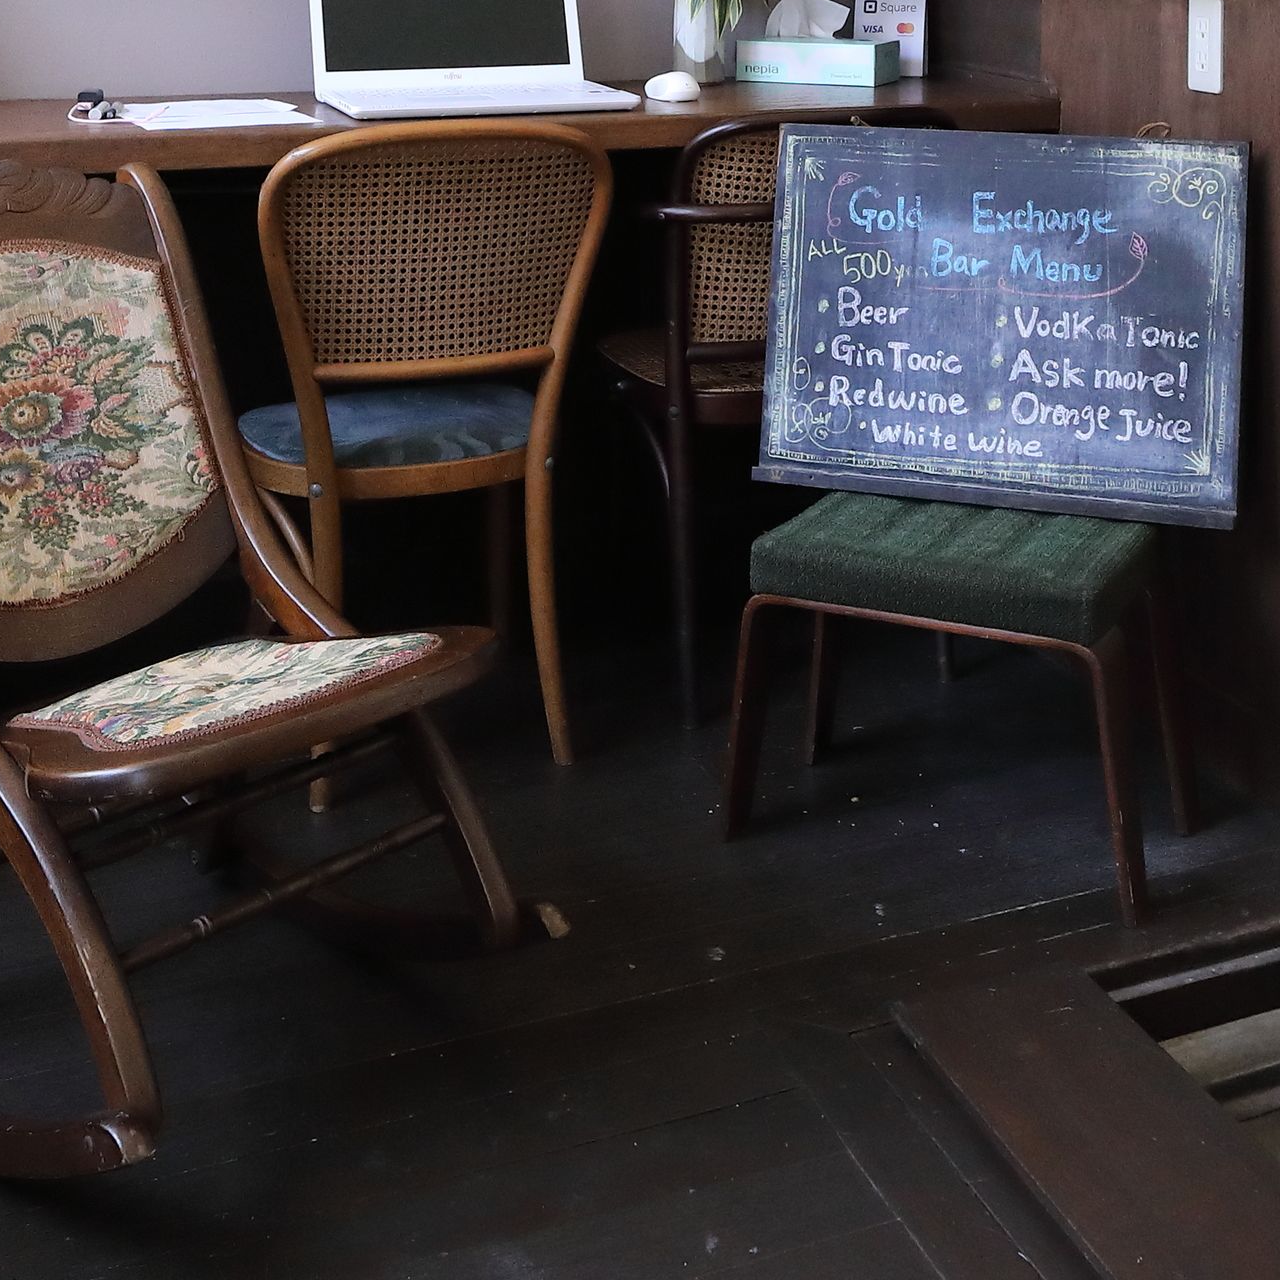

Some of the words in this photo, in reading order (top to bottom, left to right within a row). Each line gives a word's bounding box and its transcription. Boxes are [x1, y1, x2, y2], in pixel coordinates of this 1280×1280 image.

[880, 2, 917, 14] Square
[862, 25, 884, 33] VISA
[744, 64, 779, 75] nepia
[848, 185, 921, 233] Gold
[972, 191, 1118, 244] Exchange
[808, 238, 847, 261] ALL
[843, 249, 891, 283] 500
[931, 237, 991, 278] Bar
[1010, 244, 1104, 283] Menu
[837, 285, 909, 327] Beer
[831, 333, 885, 366] Gin
[887, 341, 963, 374] Tonic
[1008, 348, 1085, 389] Ask
[1094, 361, 1189, 402] more!
[1011, 391, 1110, 441] Orange
[1115, 408, 1193, 444] Juice
[871, 419, 958, 451] White
[967, 428, 1043, 458] wine
